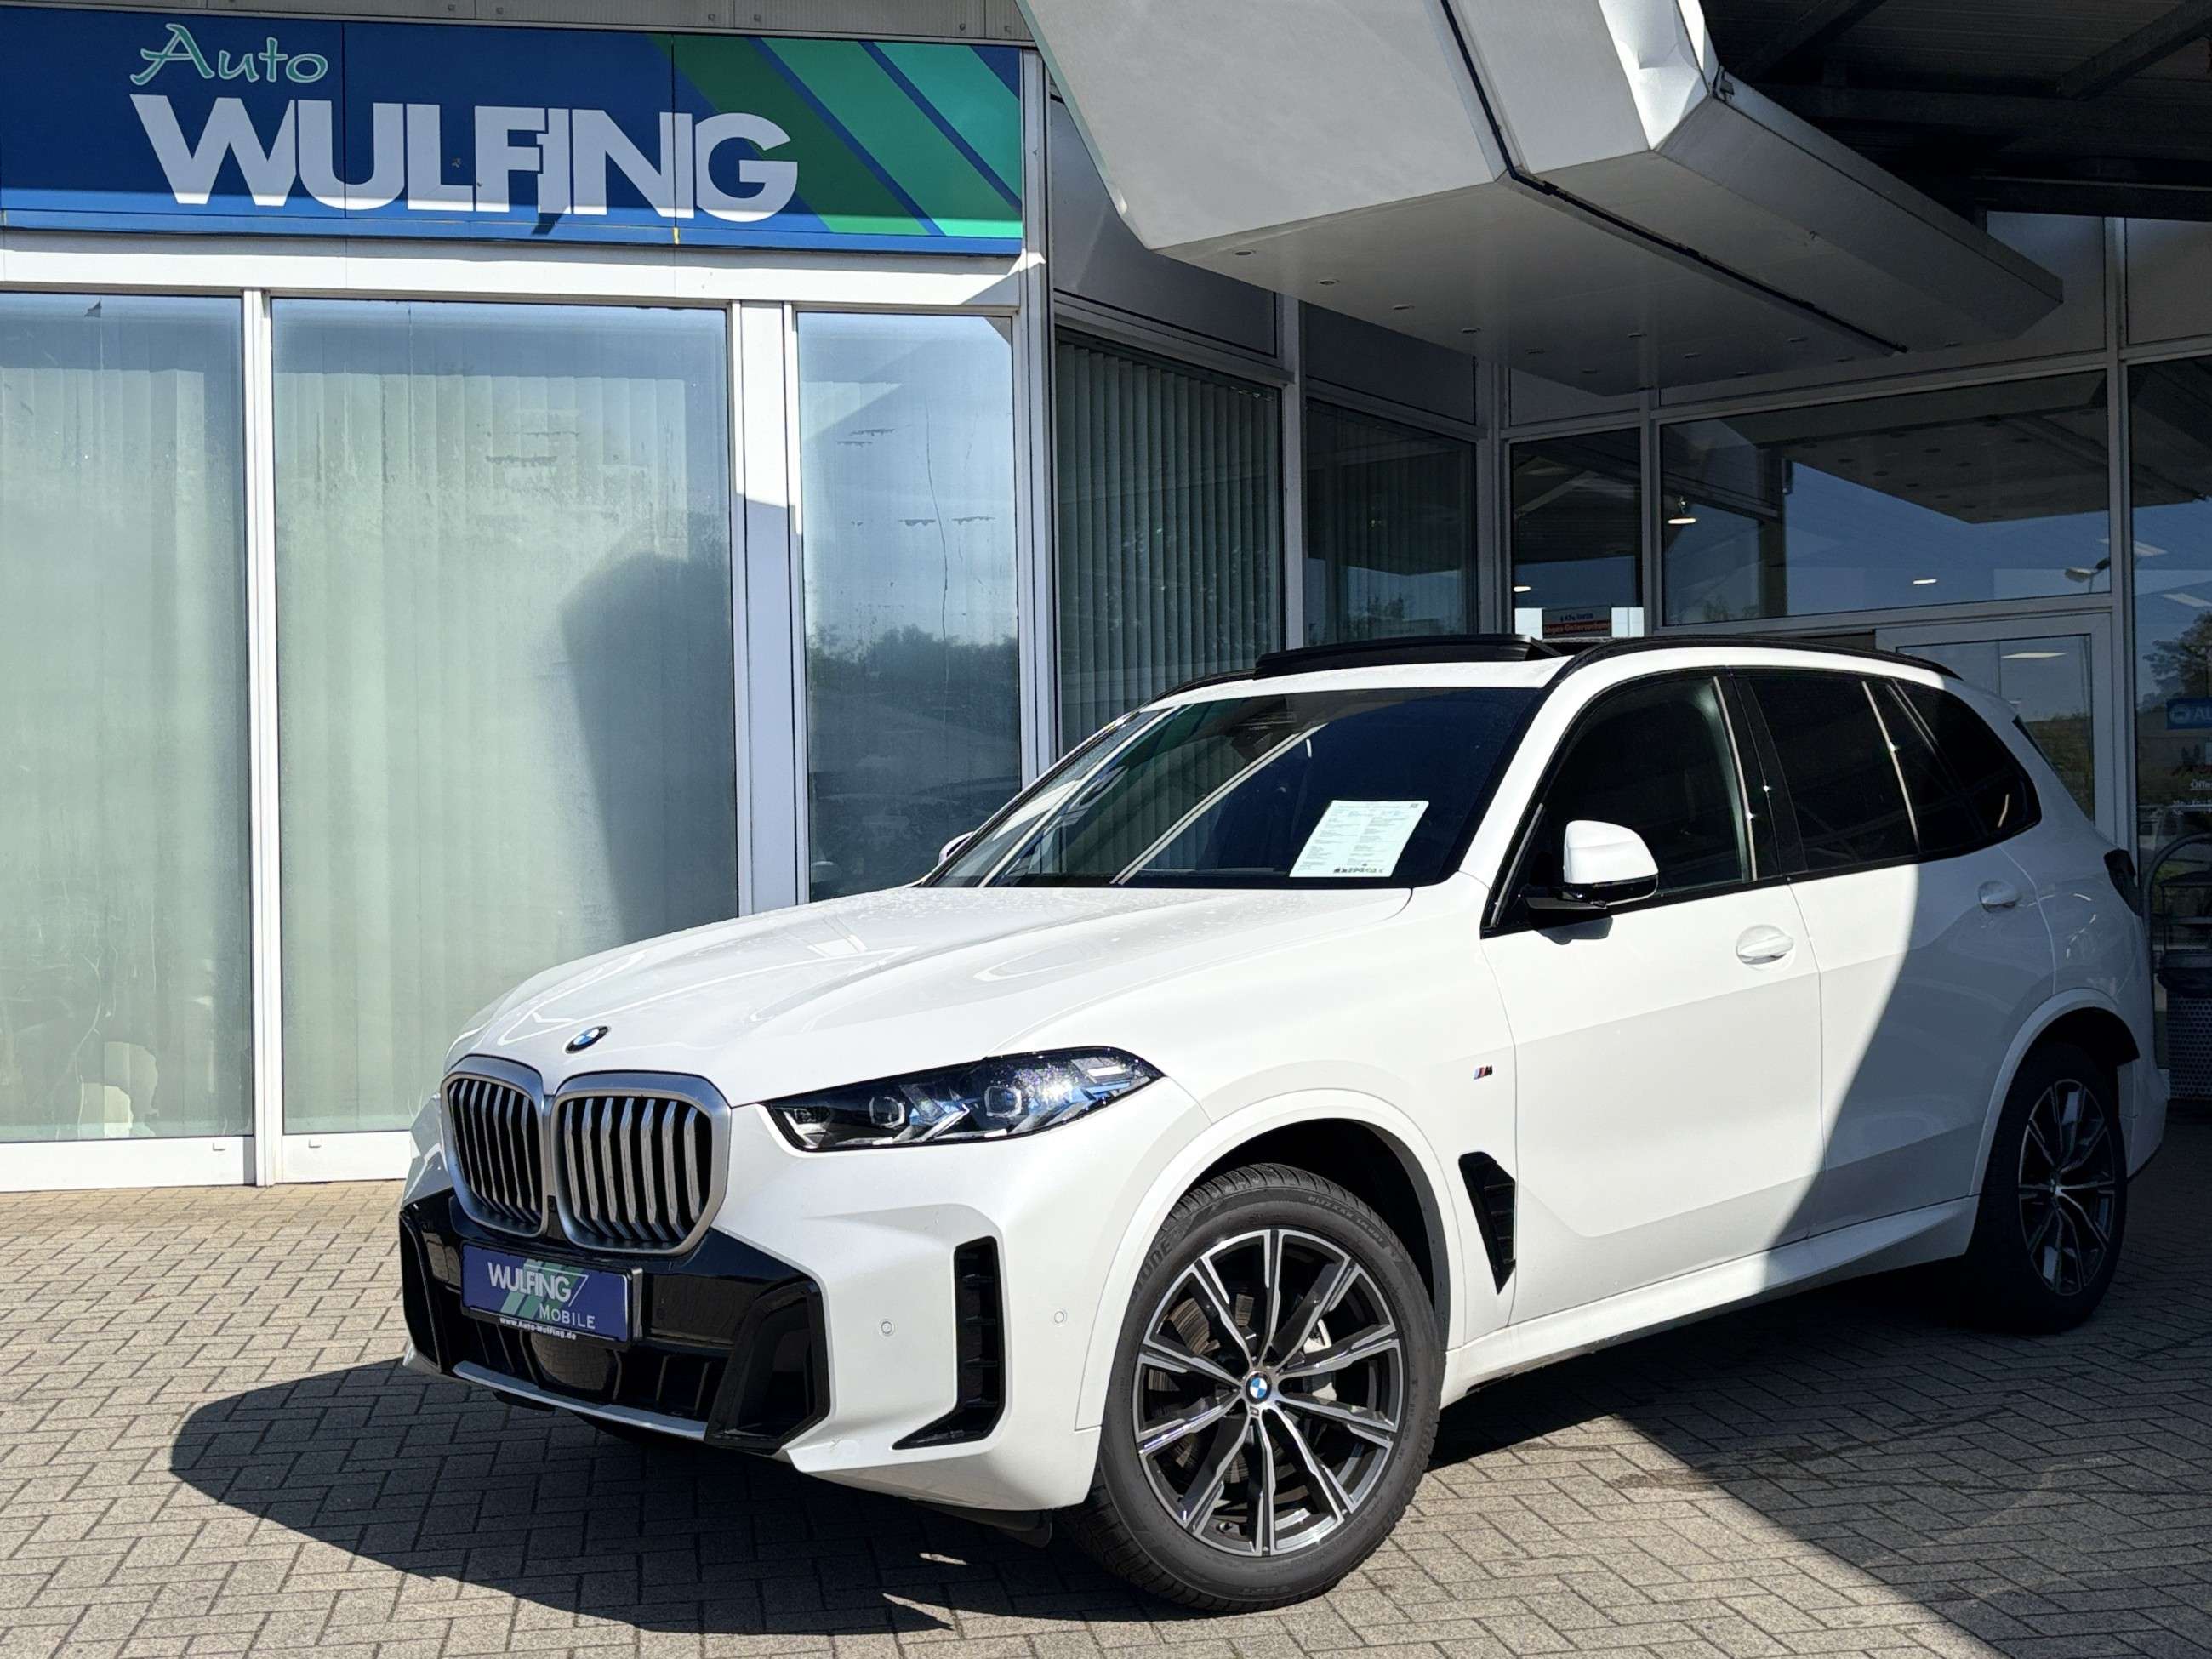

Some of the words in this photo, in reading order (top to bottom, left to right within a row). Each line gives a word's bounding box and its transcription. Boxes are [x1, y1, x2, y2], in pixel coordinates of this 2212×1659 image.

[129, 22, 329, 86] Auto
[129, 94, 799, 223] WULFING
[487, 1262, 572, 1303] WULFING
[539, 1303, 596, 1330] MOBILE
